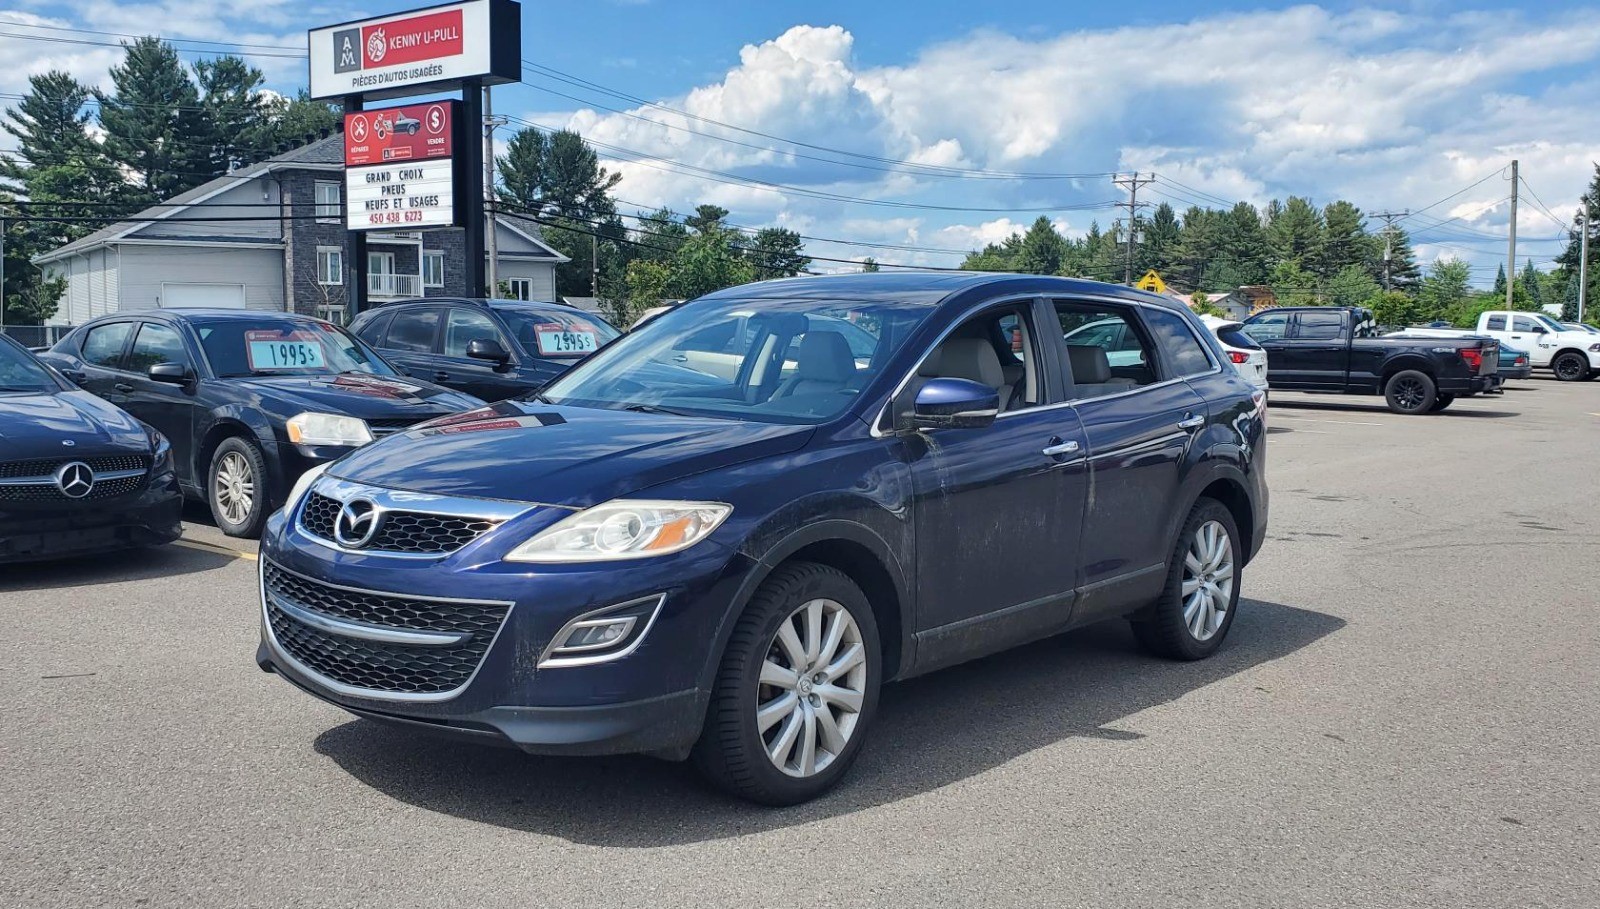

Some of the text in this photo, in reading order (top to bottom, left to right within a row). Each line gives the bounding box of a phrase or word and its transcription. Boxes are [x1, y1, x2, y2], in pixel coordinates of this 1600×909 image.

[389, 26, 459, 50] KENNY U-PULL
[352, 64, 443, 88] PIÈCES D'AUTOS USAGÉES
[366, 168, 423, 183] GRAND CHOIX
[381, 184, 406, 196] PNEUS
[365, 195, 439, 210] NEUFS ET USAGES
[369, 210, 422, 223] 450 438 6273
